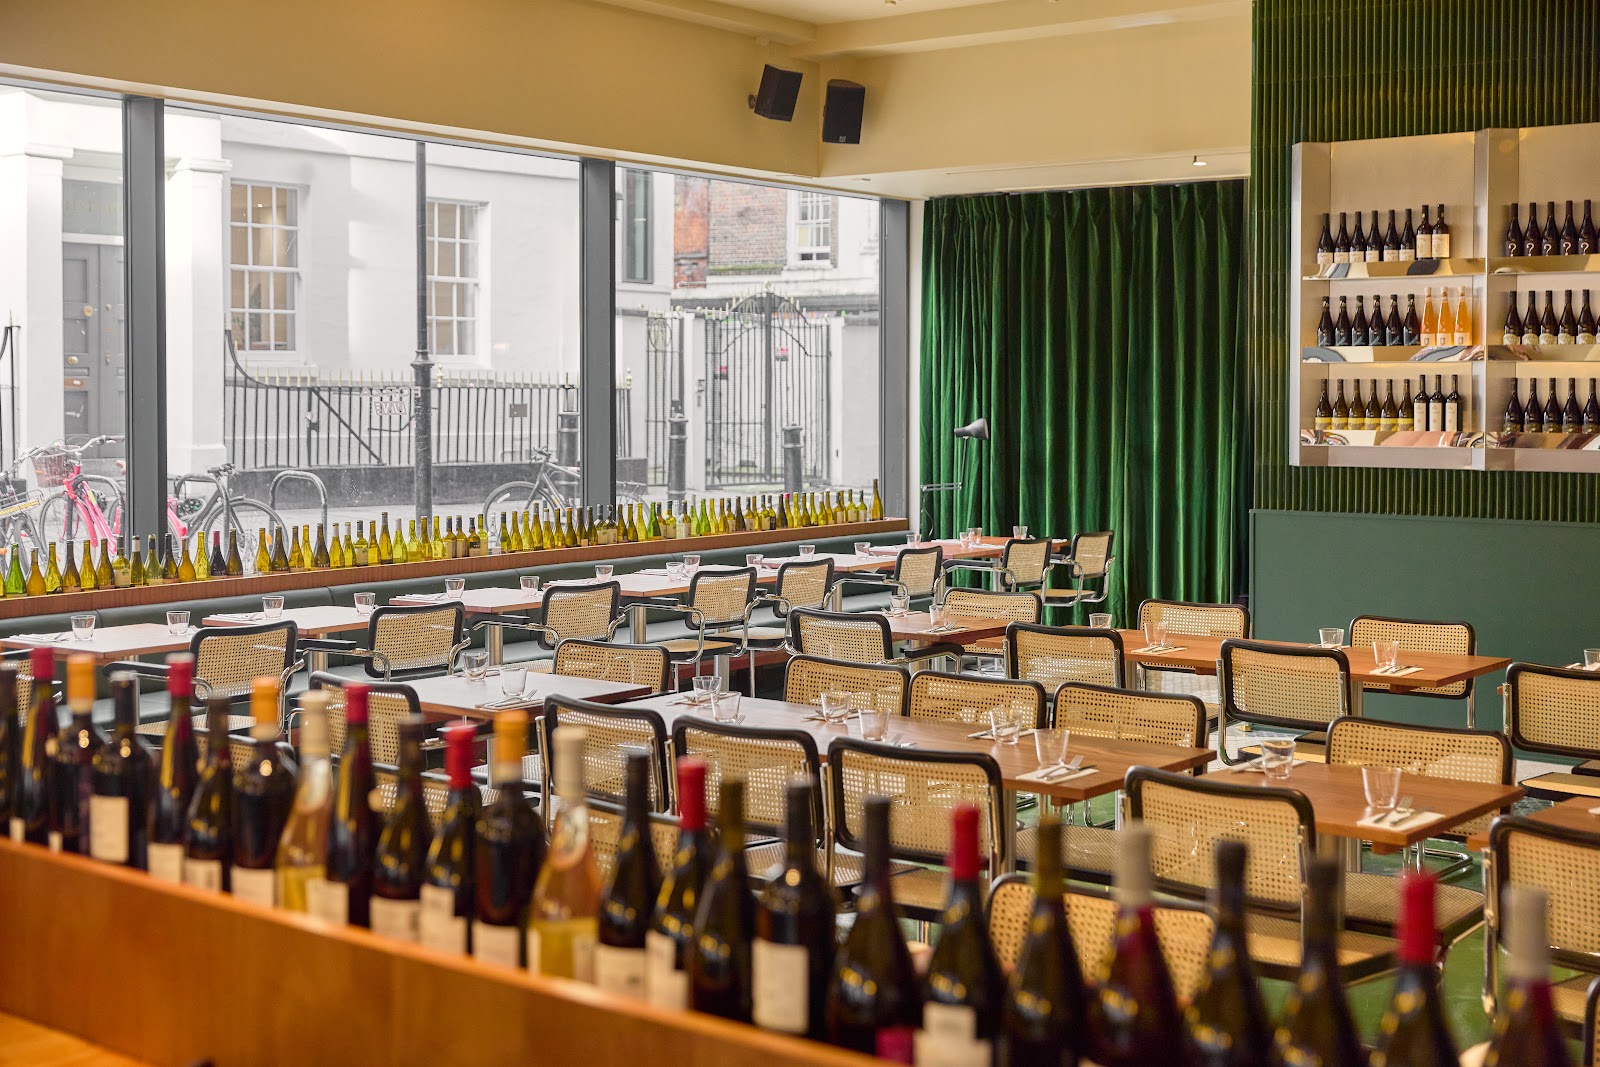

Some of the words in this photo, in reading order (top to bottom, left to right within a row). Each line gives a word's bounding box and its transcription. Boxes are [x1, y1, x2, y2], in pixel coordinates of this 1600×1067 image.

[1508, 243, 1517, 257] ?
[1526, 242, 1535, 257] ?
[1543, 243, 1552, 257] ?
[1563, 241, 1572, 257] ?
[1580, 242, 1589, 256] ?
